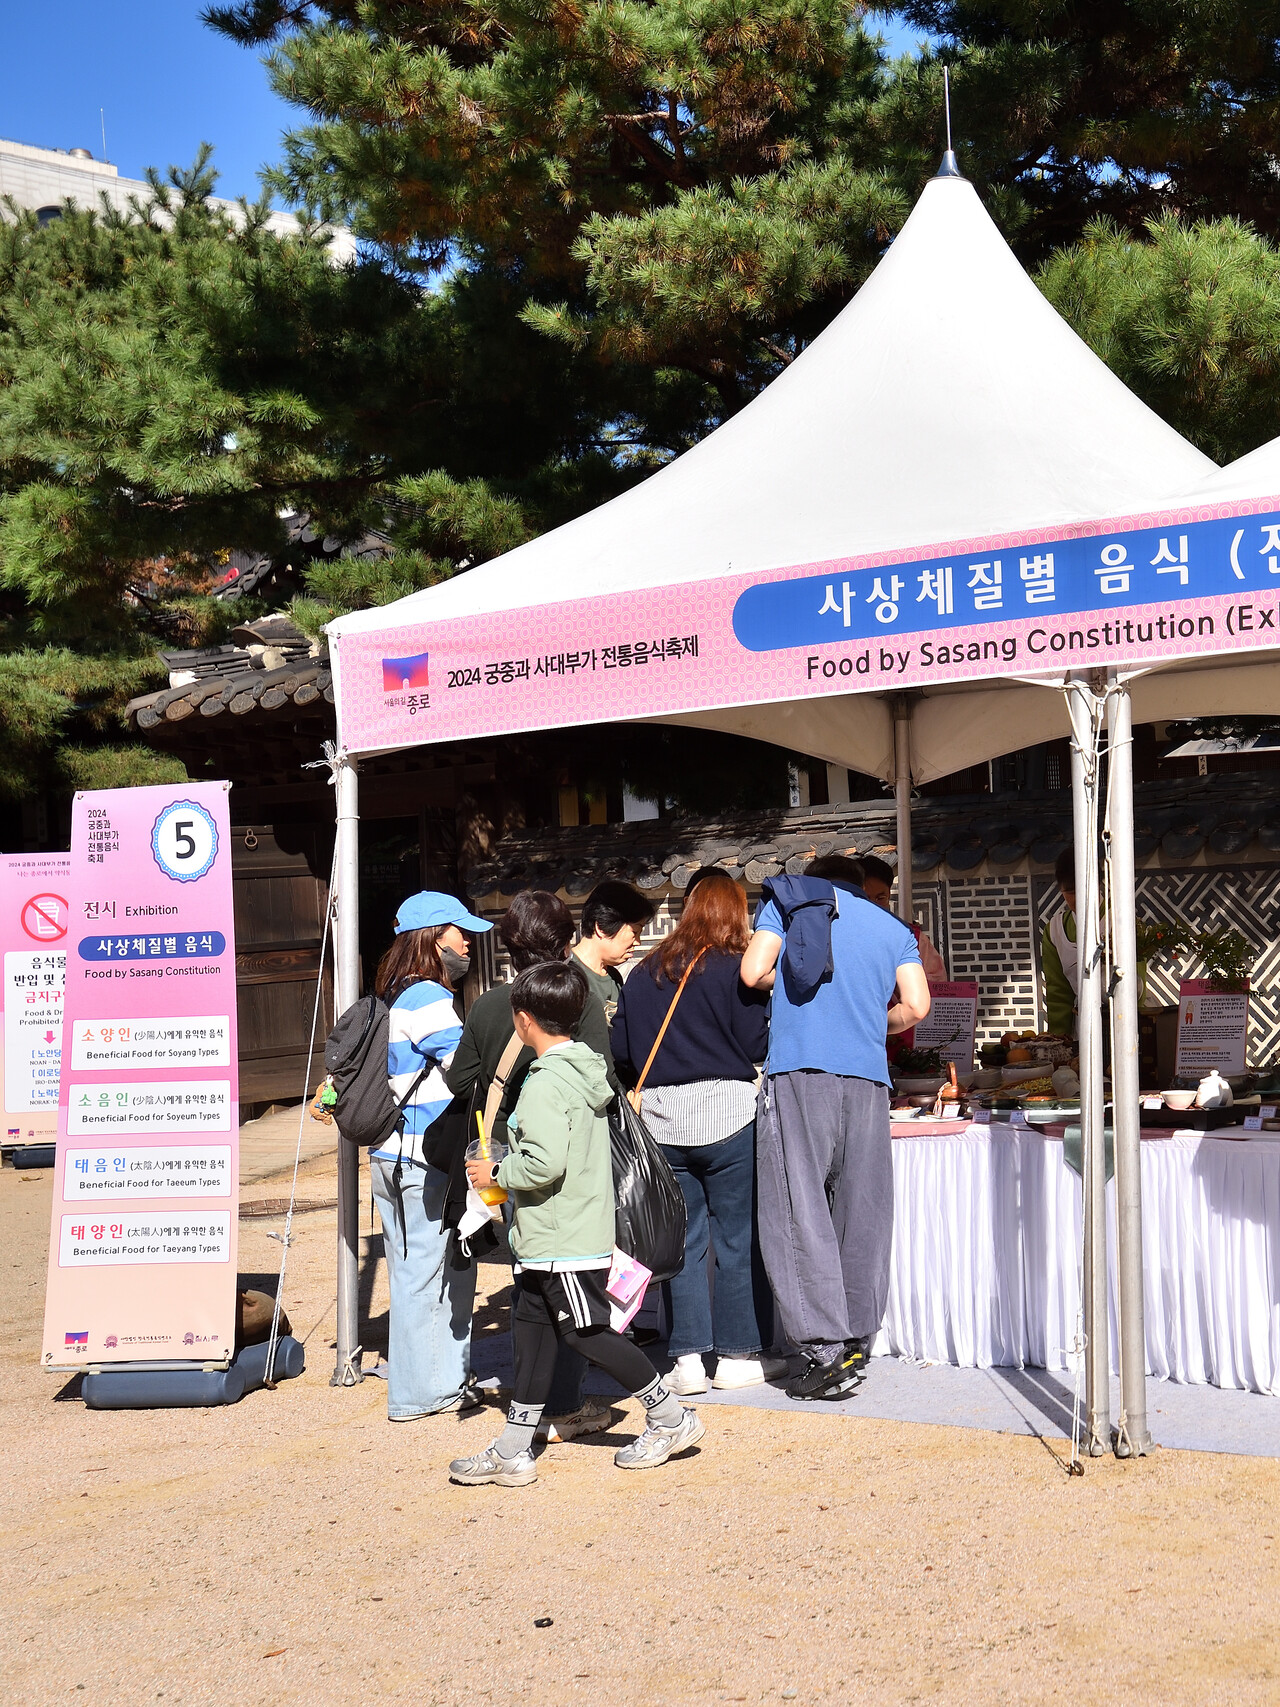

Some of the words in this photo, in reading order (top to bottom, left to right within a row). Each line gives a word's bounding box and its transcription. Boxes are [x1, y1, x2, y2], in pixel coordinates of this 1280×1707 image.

[818, 555, 1055, 629] 사상체질별
[1094, 539, 1190, 594] 음식
[807, 650, 872, 680] Food
[879, 646, 911, 678] by
[920, 633, 1017, 672] Sasang
[1028, 612, 1215, 656] Constitution
[447, 671, 481, 688] 2024
[484, 664, 530, 686] 궁중과
[534, 649, 598, 677] 사대부가
[601, 634, 699, 668] 전통음식축제
[407, 694, 431, 715] 종로
[88, 809, 107, 818] 2024
[88, 820, 111, 830] 궁중과
[88, 831, 119, 841] 사대부가
[176, 821, 196, 859] 5
[88, 842, 119, 853] 전통음식
[88, 854, 104, 863] 축제
[84, 901, 116, 919] 전시
[126, 905, 178, 916] Exhibition
[97, 936, 177, 956] 사상체질별
[185, 935, 212, 953] 음식
[85, 969, 112, 979] Food
[115, 968, 127, 980] by
[130, 967, 163, 978] Sasang
[166, 965, 221, 976] Constitution
[14, 974, 38, 987] 반입
[43, 974, 54, 986] 및
[25, 991, 65, 1003] 금지구
[20, 1018, 60, 1026] Prohibited
[185, 1029, 207, 1039] 유익한
[209, 1029, 223, 1039] 음식
[87, 1050, 130, 1059] Beneficial
[132, 1050, 152, 1058] Food
[155, 1049, 166, 1057] for
[168, 1048, 196, 1058] Soyang
[198, 1048, 219, 1056] Types
[185, 1095, 207, 1104] 유익한
[209, 1094, 224, 1104] 음식
[82, 1114, 126, 1123] Beneficial
[129, 1114, 150, 1122] Food
[152, 1113, 164, 1121] for
[167, 1112, 197, 1121] Soyeum
[199, 1112, 220, 1120] Types
[184, 1160, 207, 1169] 유익한
[209, 1159, 224, 1169] 음식
[79, 1180, 125, 1189] Beneficial
[127, 1180, 149, 1188] Food
[151, 1179, 163, 1187] for
[166, 1178, 197, 1187] Taeeum
[199, 1178, 220, 1187] Types
[183, 1226, 206, 1236] 유익한
[208, 1226, 224, 1236] 음식
[73, 1246, 120, 1256] Beneficial
[122, 1246, 145, 1254] Food
[147, 1245, 160, 1253] for
[162, 1244, 197, 1254] Taeyang
[199, 1244, 221, 1253] Types
[643, 1385, 667, 1406] 84
